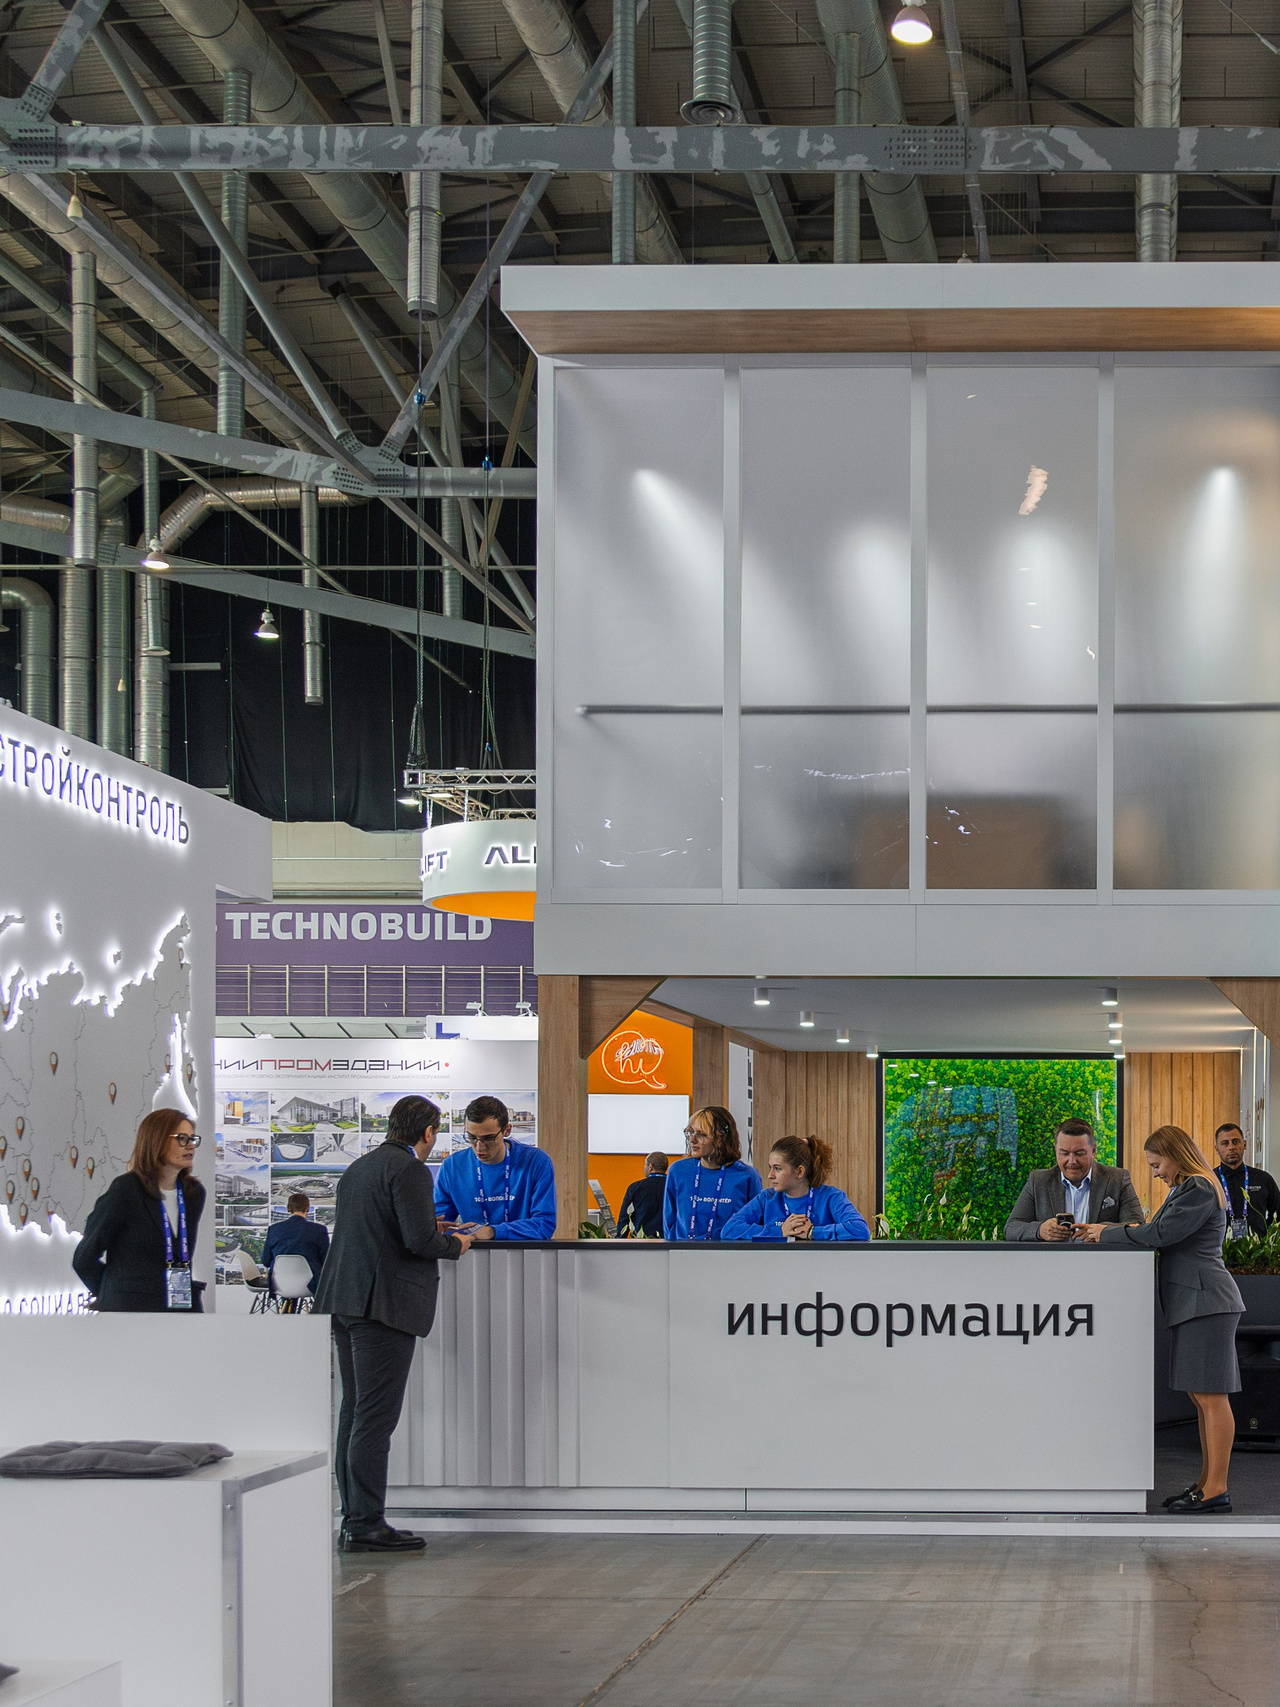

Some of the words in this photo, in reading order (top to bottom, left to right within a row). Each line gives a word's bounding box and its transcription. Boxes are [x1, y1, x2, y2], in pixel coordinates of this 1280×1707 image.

[421, 851, 448, 876] IFT
[484, 845, 537, 865] AL
[225, 911, 493, 941] TECHNOBUILD
[727, 1291, 1094, 1347] информация
